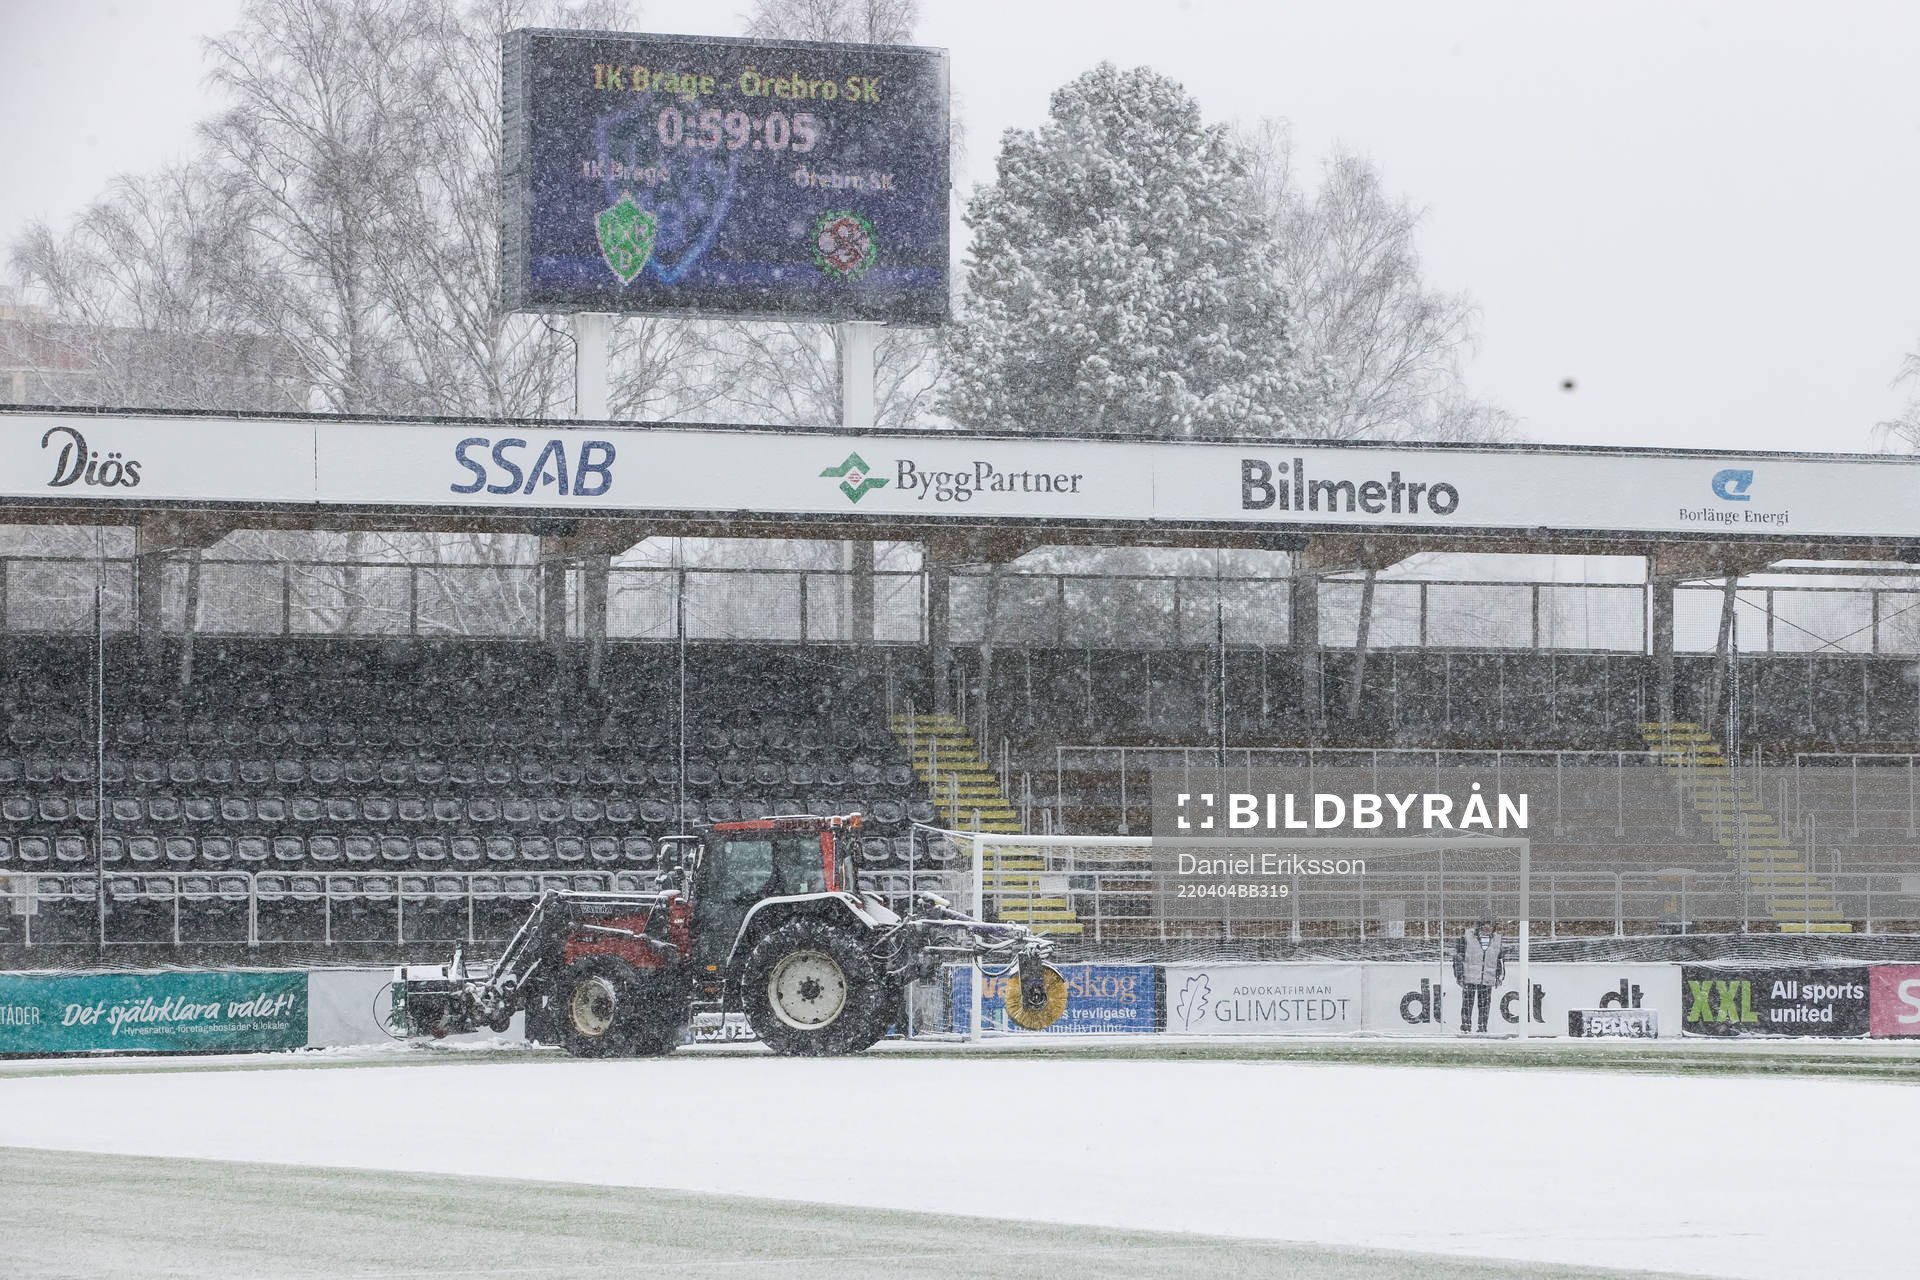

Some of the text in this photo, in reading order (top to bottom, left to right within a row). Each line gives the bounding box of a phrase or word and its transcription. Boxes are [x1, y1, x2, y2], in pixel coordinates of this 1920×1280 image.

[594, 63, 625, 91] IK
[632, 64, 716, 102] Brage
[739, 65, 838, 100] Örebro
[846, 76, 880, 103] SK
[657, 106, 817, 151] 0:59:05
[41, 426, 142, 488] Diös
[450, 438, 616, 496] SSAB
[895, 458, 1083, 502] ByggPartner
[1242, 458, 1460, 516] Bilmetro
[1679, 508, 1790, 526] Borlänge Energi
[1214, 998, 1351, 1022] GLIMSTEDT
[1233, 985, 1333, 996] ADVOKATFIRMAN
[1687, 980, 1759, 1023] XXL
[1771, 981, 1865, 1003] All sports
[0, 1004, 40, 1025] TÄDER
[61, 992, 295, 1035] Det självklara valet!
[1072, 1007, 1137, 1020] trevligaste
[1770, 1004, 1833, 1023] united
